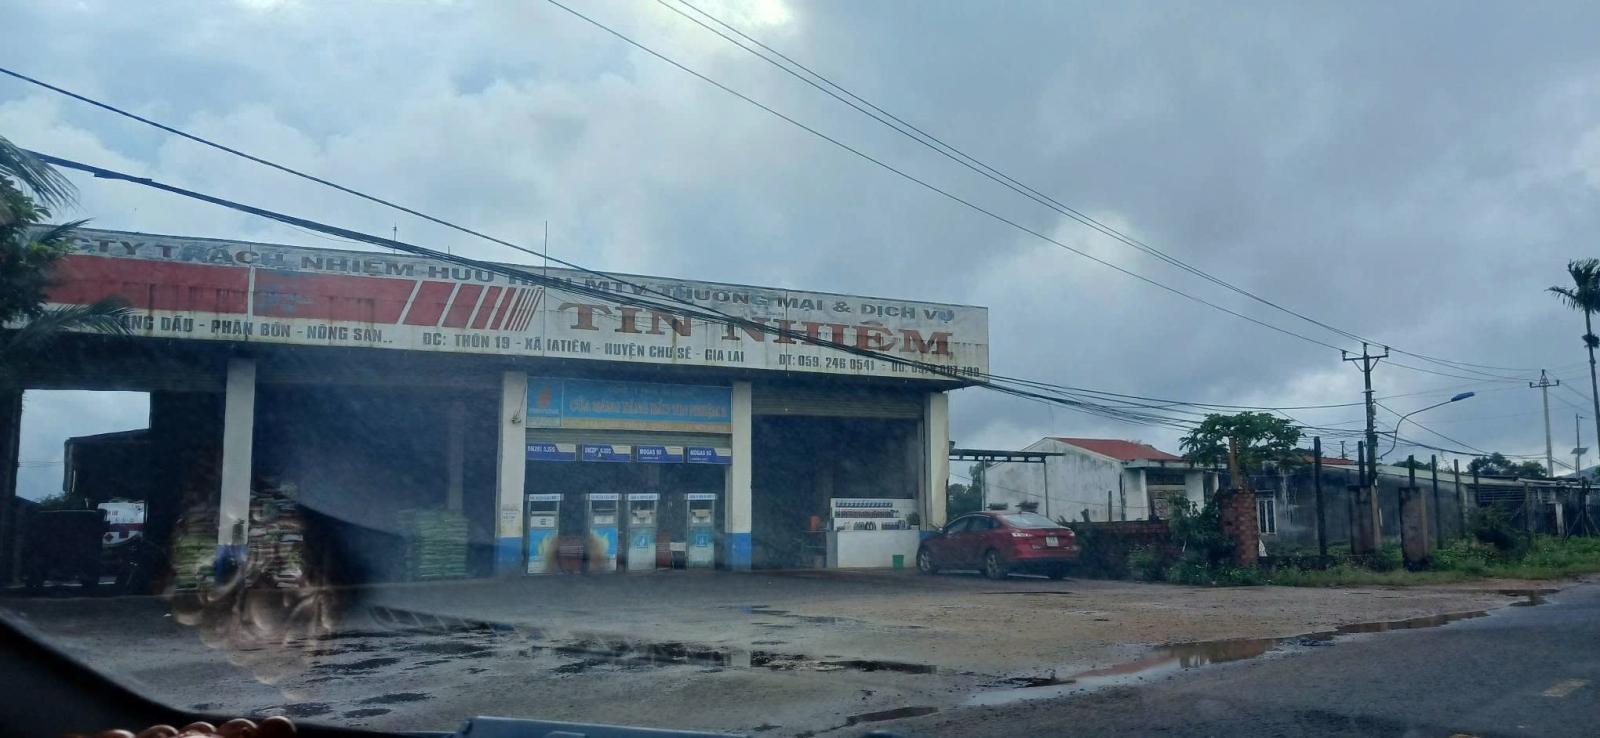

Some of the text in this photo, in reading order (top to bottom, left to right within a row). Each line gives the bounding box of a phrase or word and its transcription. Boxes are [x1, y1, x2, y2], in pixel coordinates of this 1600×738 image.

[832, 300, 851, 313] &
[494, 336, 510, 349] 19
[728, 350, 744, 363] LAI
[825, 356, 846, 369] 246
[849, 358, 875, 371] 0541
